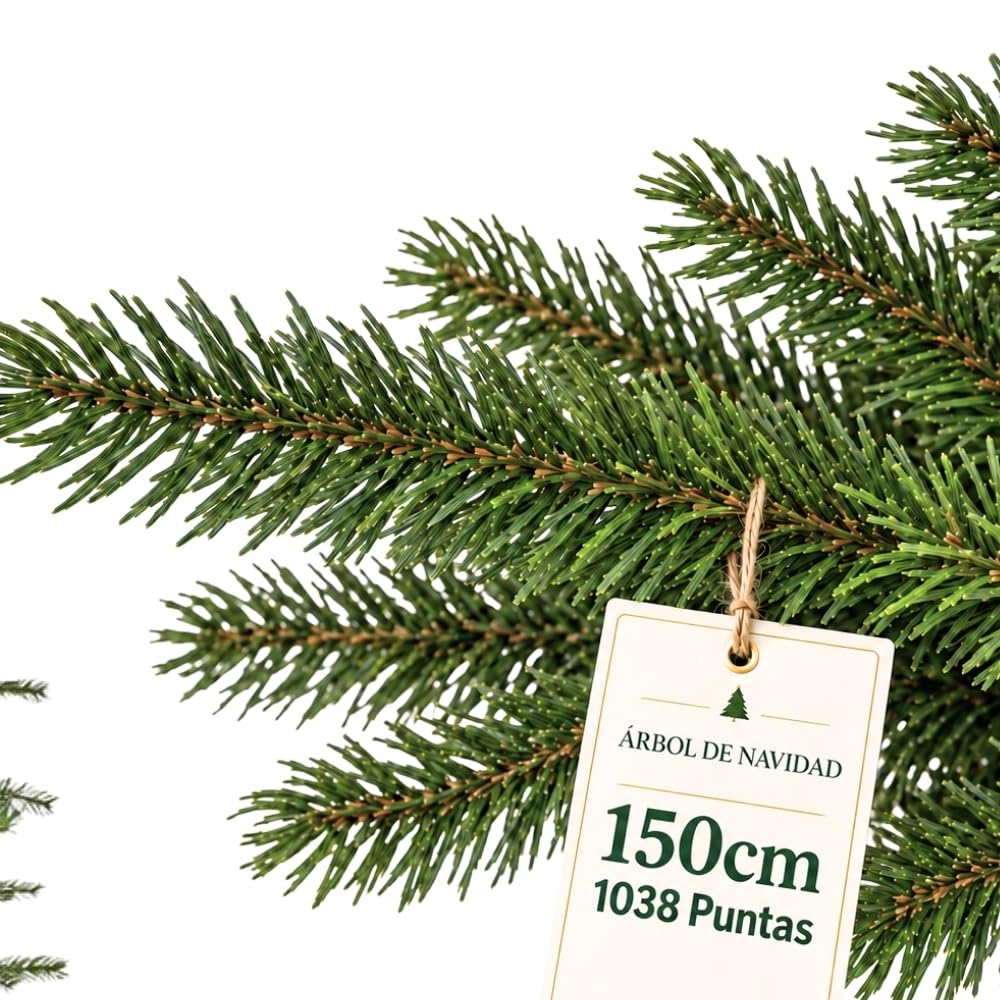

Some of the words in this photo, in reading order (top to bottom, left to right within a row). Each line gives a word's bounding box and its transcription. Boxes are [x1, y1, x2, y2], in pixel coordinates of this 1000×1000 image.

[618, 725, 697, 758] ÁRBOL
[702, 740, 733, 763] DE
[738, 746, 844, 780] NAVIDAD
[600, 803, 821, 894] 150cm
[593, 878, 681, 923] 1038
[688, 892, 814, 946] Puntas
